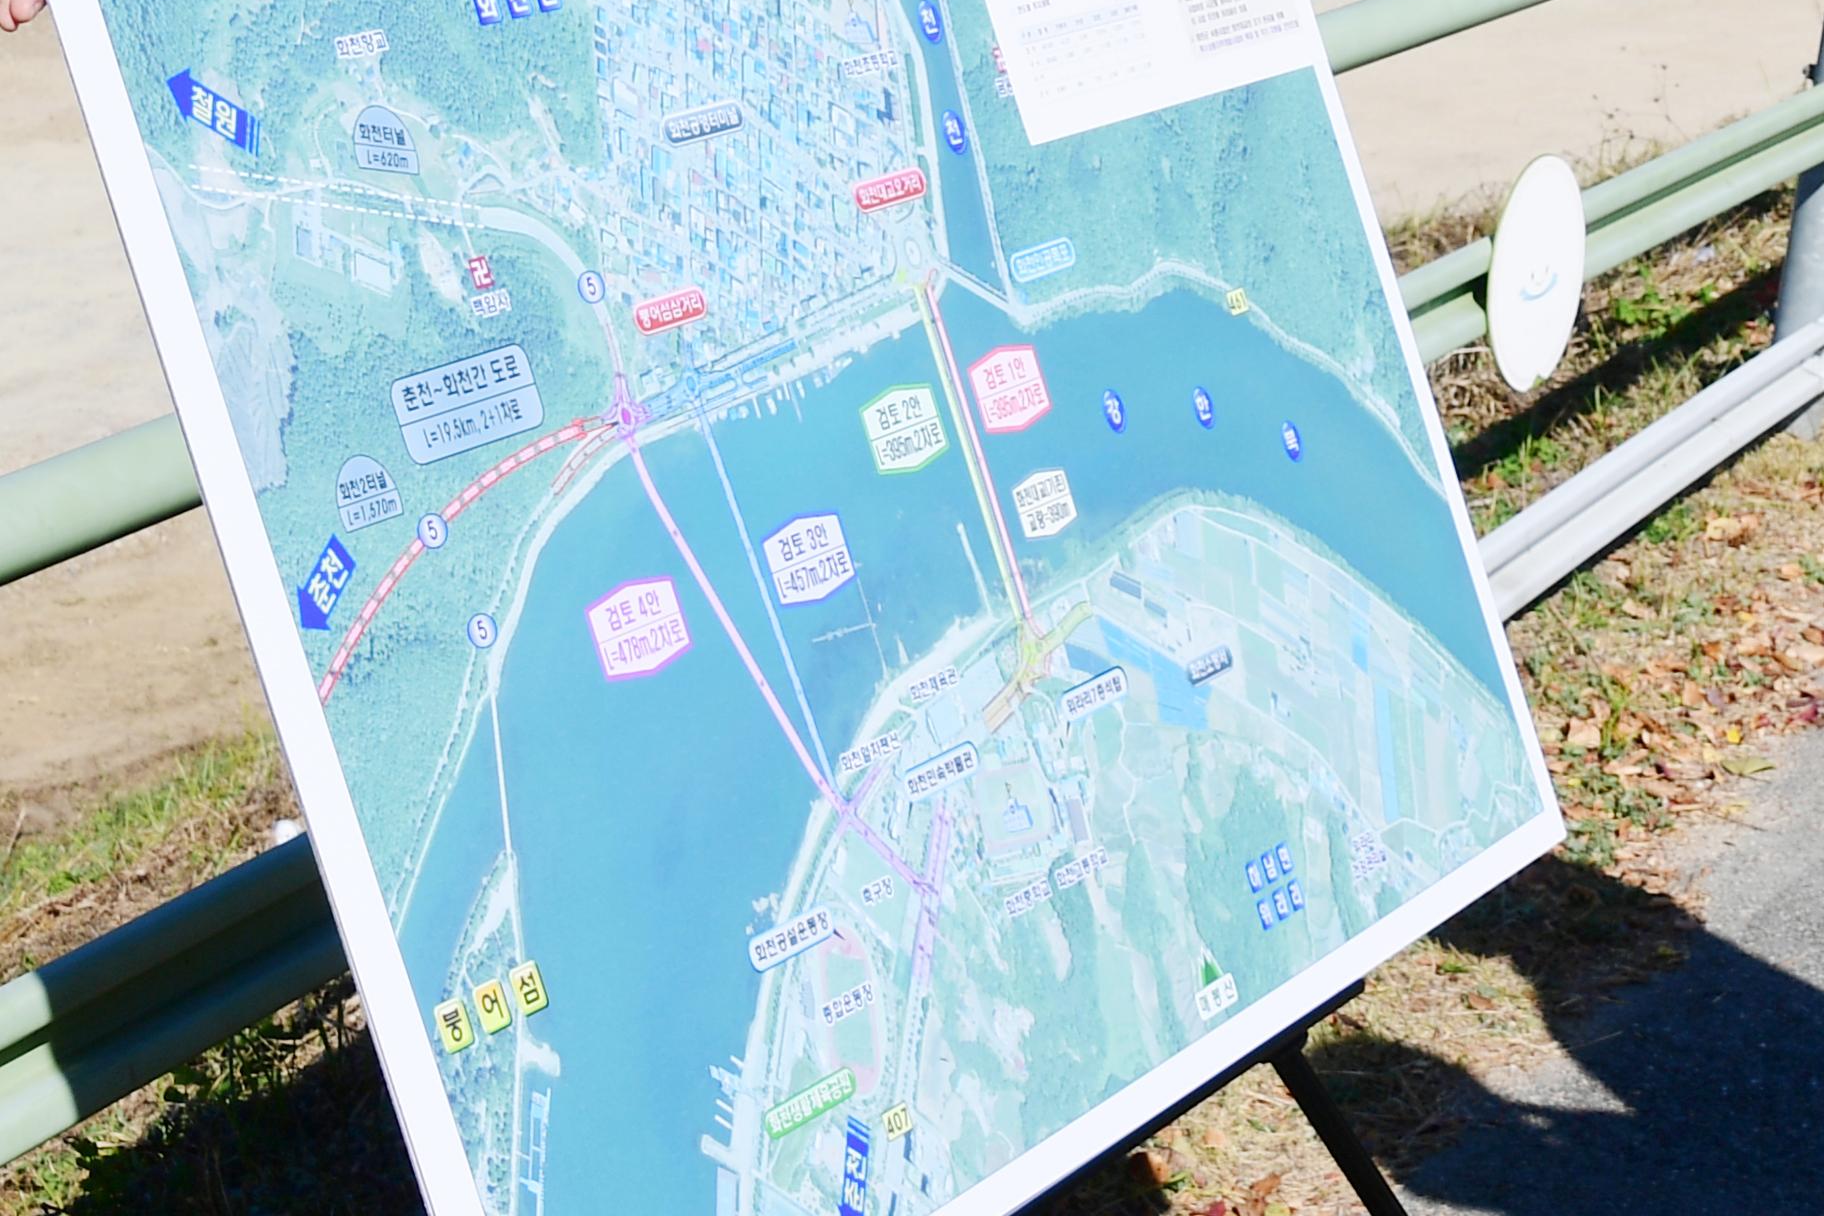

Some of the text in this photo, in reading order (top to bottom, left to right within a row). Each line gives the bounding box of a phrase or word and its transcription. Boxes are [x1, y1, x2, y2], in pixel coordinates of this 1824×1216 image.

[919, 7, 939, 34] 천
[336, 31, 387, 57] 화천향교
[843, 50, 897, 75] 화천초등학교
[191, 86, 237, 140] 철원
[359, 123, 406, 146] 화천터널
[944, 119, 963, 145] 천
[367, 150, 409, 169] L=620m
[858, 174, 922, 207] 화천대교오거리
[585, 278, 596, 295] 5
[471, 291, 510, 316] 백암사
[636, 292, 702, 328] 붕어섬삼거리
[400, 355, 519, 411] 춘천~화천간 도로
[983, 356, 1027, 390] 검토 1안
[423, 399, 522, 449] L=19.5km, 2+1차로
[875, 394, 922, 430] 검토 2안
[338, 471, 387, 501] 화천2터널
[346, 496, 398, 526] L=1,570m
[426, 520, 438, 539] 5
[778, 522, 829, 562] 검토 3안
[308, 548, 348, 615] 춘천
[605, 589, 661, 632] 검토 4안
[476, 620, 487, 638] 5
[907, 750, 974, 796] 화천민속박물관
[754, 910, 829, 964] 화천공설운동장
[442, 971, 540, 1044] 붕어섬
[822, 983, 874, 1025] 종합운동장
[885, 1107, 910, 1136] 407
[845, 1152, 866, 1211] 춘천
